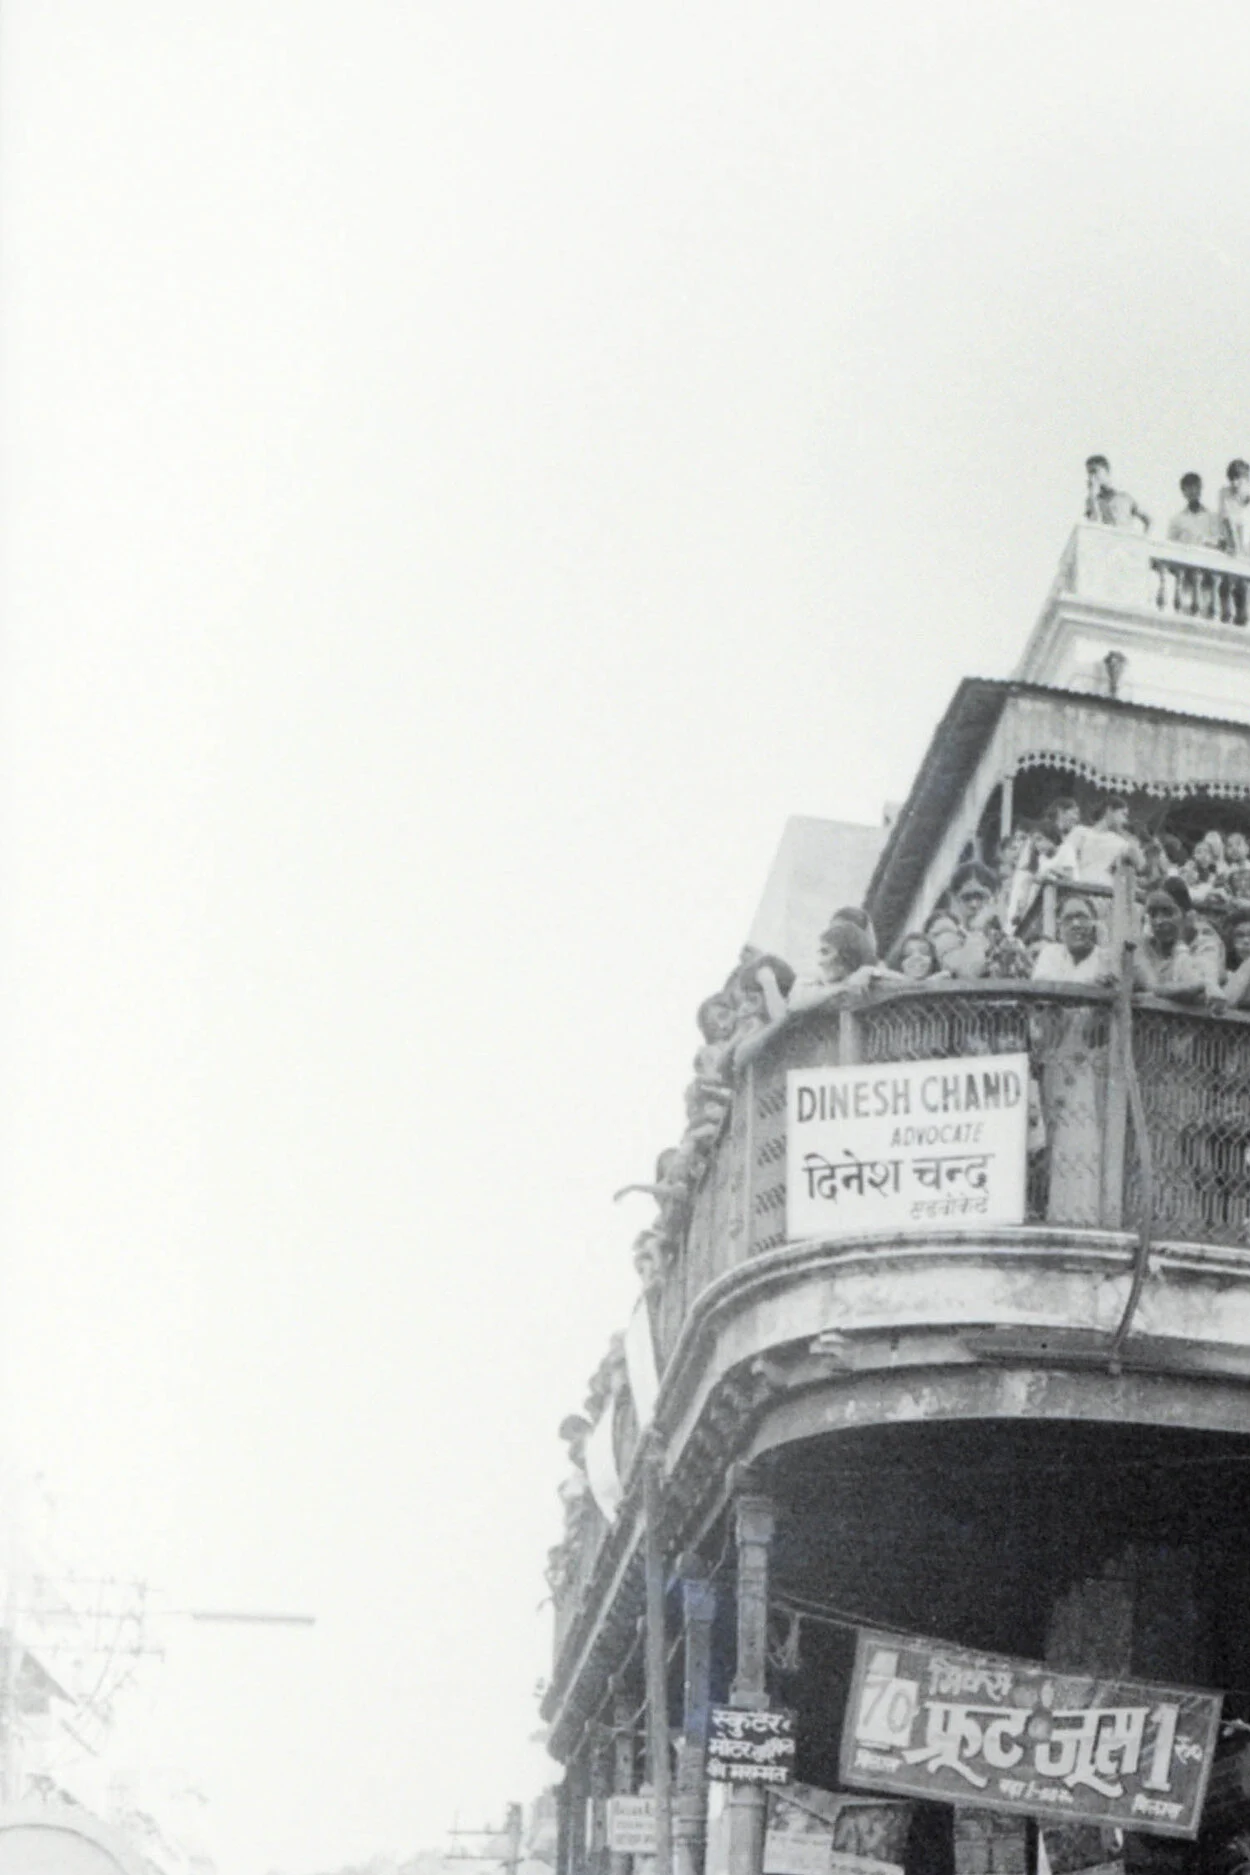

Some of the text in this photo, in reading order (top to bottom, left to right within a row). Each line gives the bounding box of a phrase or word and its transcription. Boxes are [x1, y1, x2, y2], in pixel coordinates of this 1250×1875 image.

[797, 1069, 1021, 1122] DINESH CHAND
[890, 1121, 985, 1148] ADVOCATE
[801, 1148, 904, 1205] दिनेश
[1034, 1707, 1150, 1799] जूस
[1142, 1703, 1179, 1791] 1
